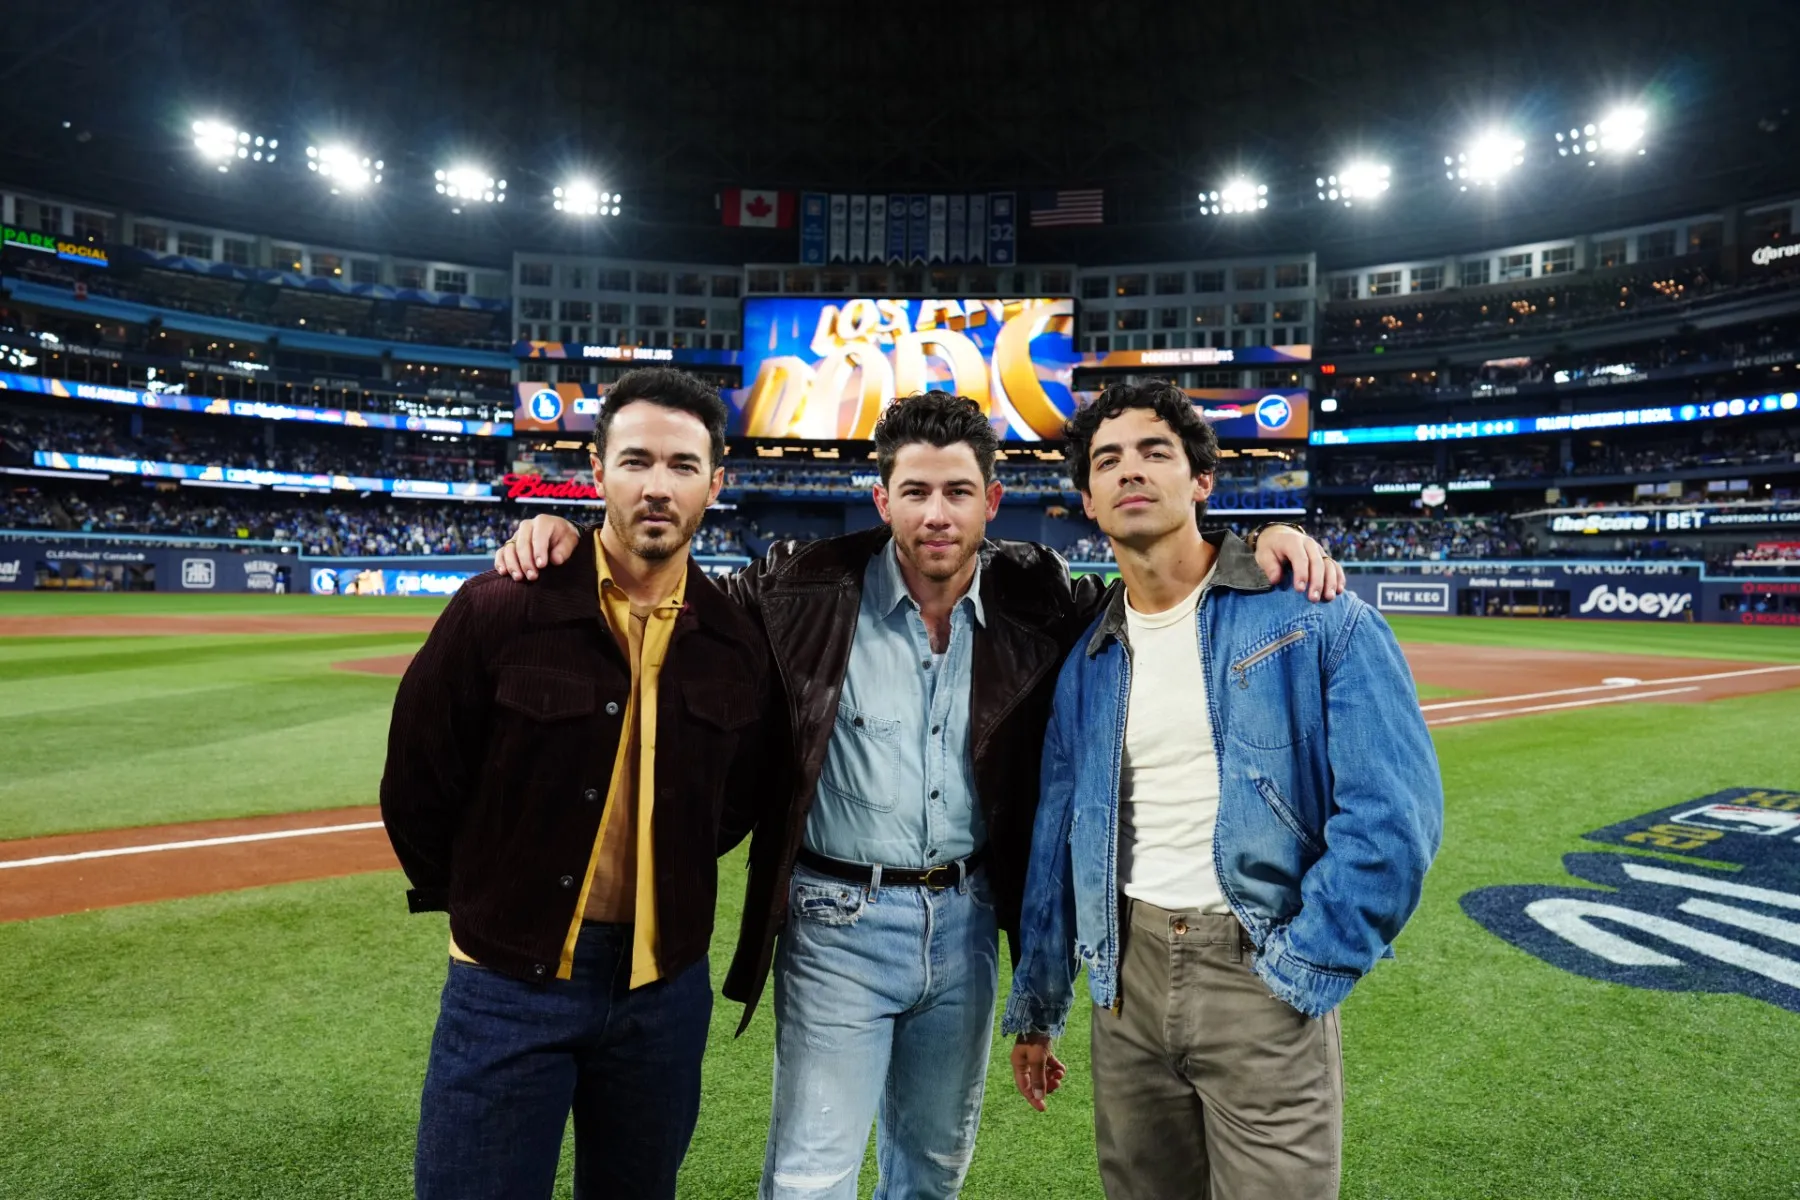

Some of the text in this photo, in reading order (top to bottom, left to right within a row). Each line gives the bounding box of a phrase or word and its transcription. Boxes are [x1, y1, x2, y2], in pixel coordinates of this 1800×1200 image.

[991, 223, 1013, 242] 32
[4, 228, 108, 262] PARK SOCIAL
[1208, 491, 1305, 509] ROGERS
[1552, 514, 1649, 532] theScore
[1667, 512, 1704, 530] BET
[1709, 514, 1769, 524] SPORTSBOOK
[243, 560, 278, 575] HEINZ
[1385, 591, 1440, 603] THE KEG
[1580, 584, 1693, 618] Sobeys
